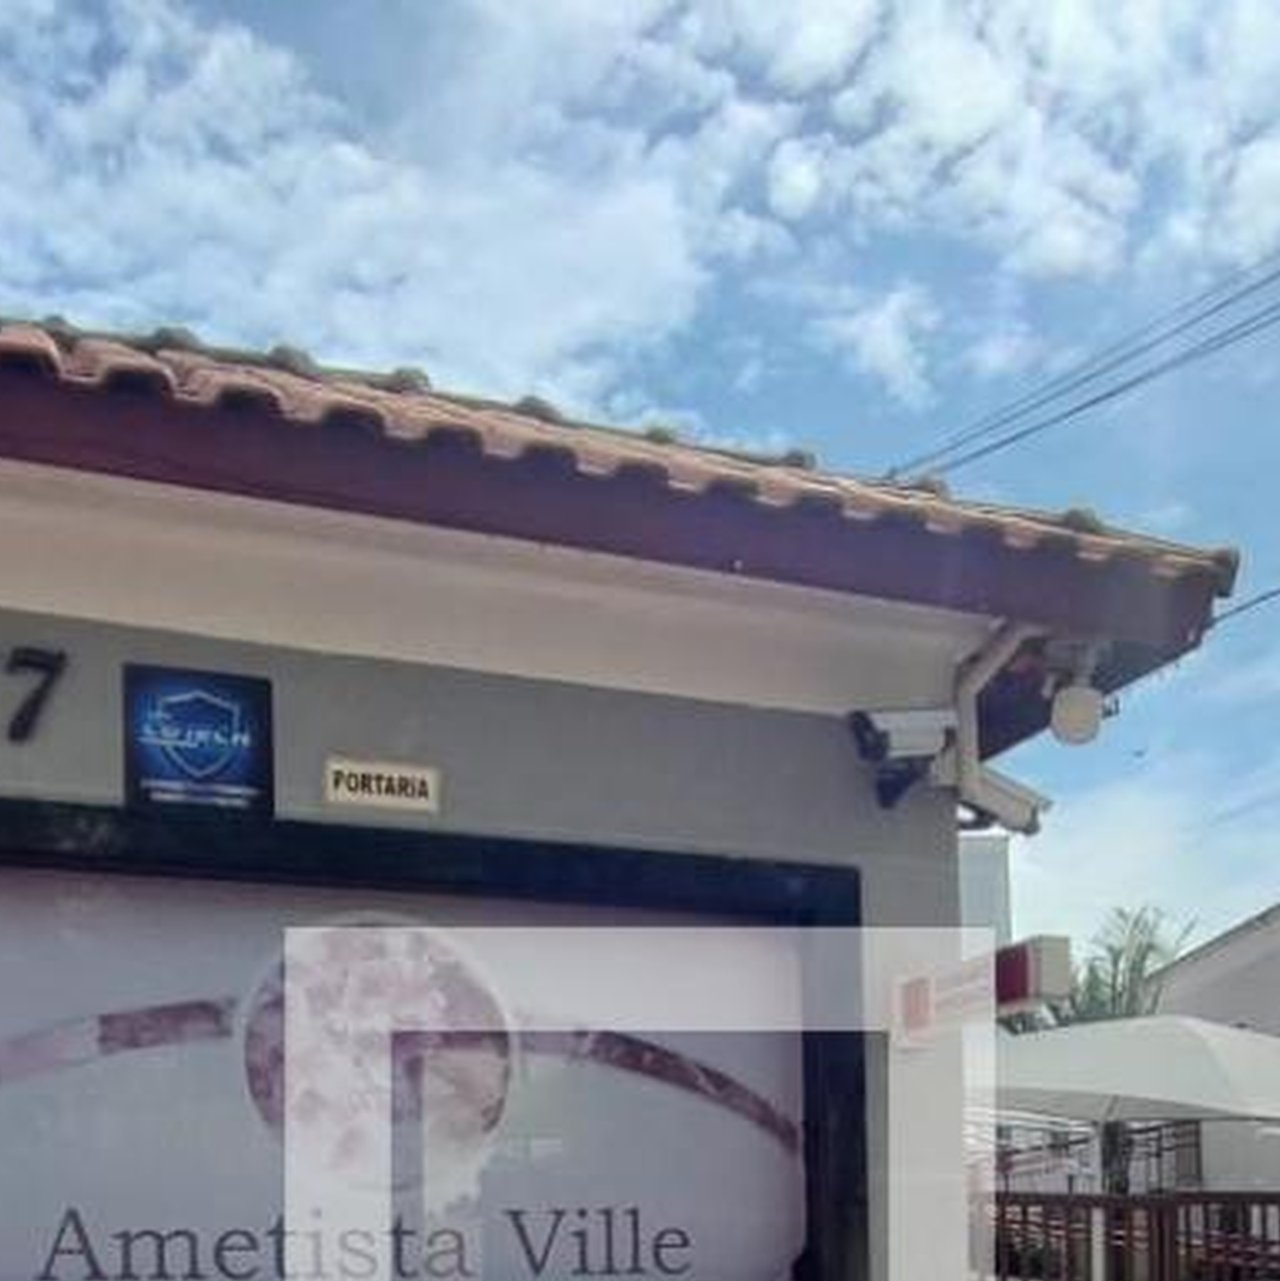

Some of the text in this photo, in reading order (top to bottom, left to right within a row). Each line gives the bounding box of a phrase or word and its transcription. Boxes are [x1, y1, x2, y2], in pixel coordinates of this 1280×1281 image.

[332, 769, 429, 799] PORTARIA
[34, 1207, 694, 1281] Ametista Ville
